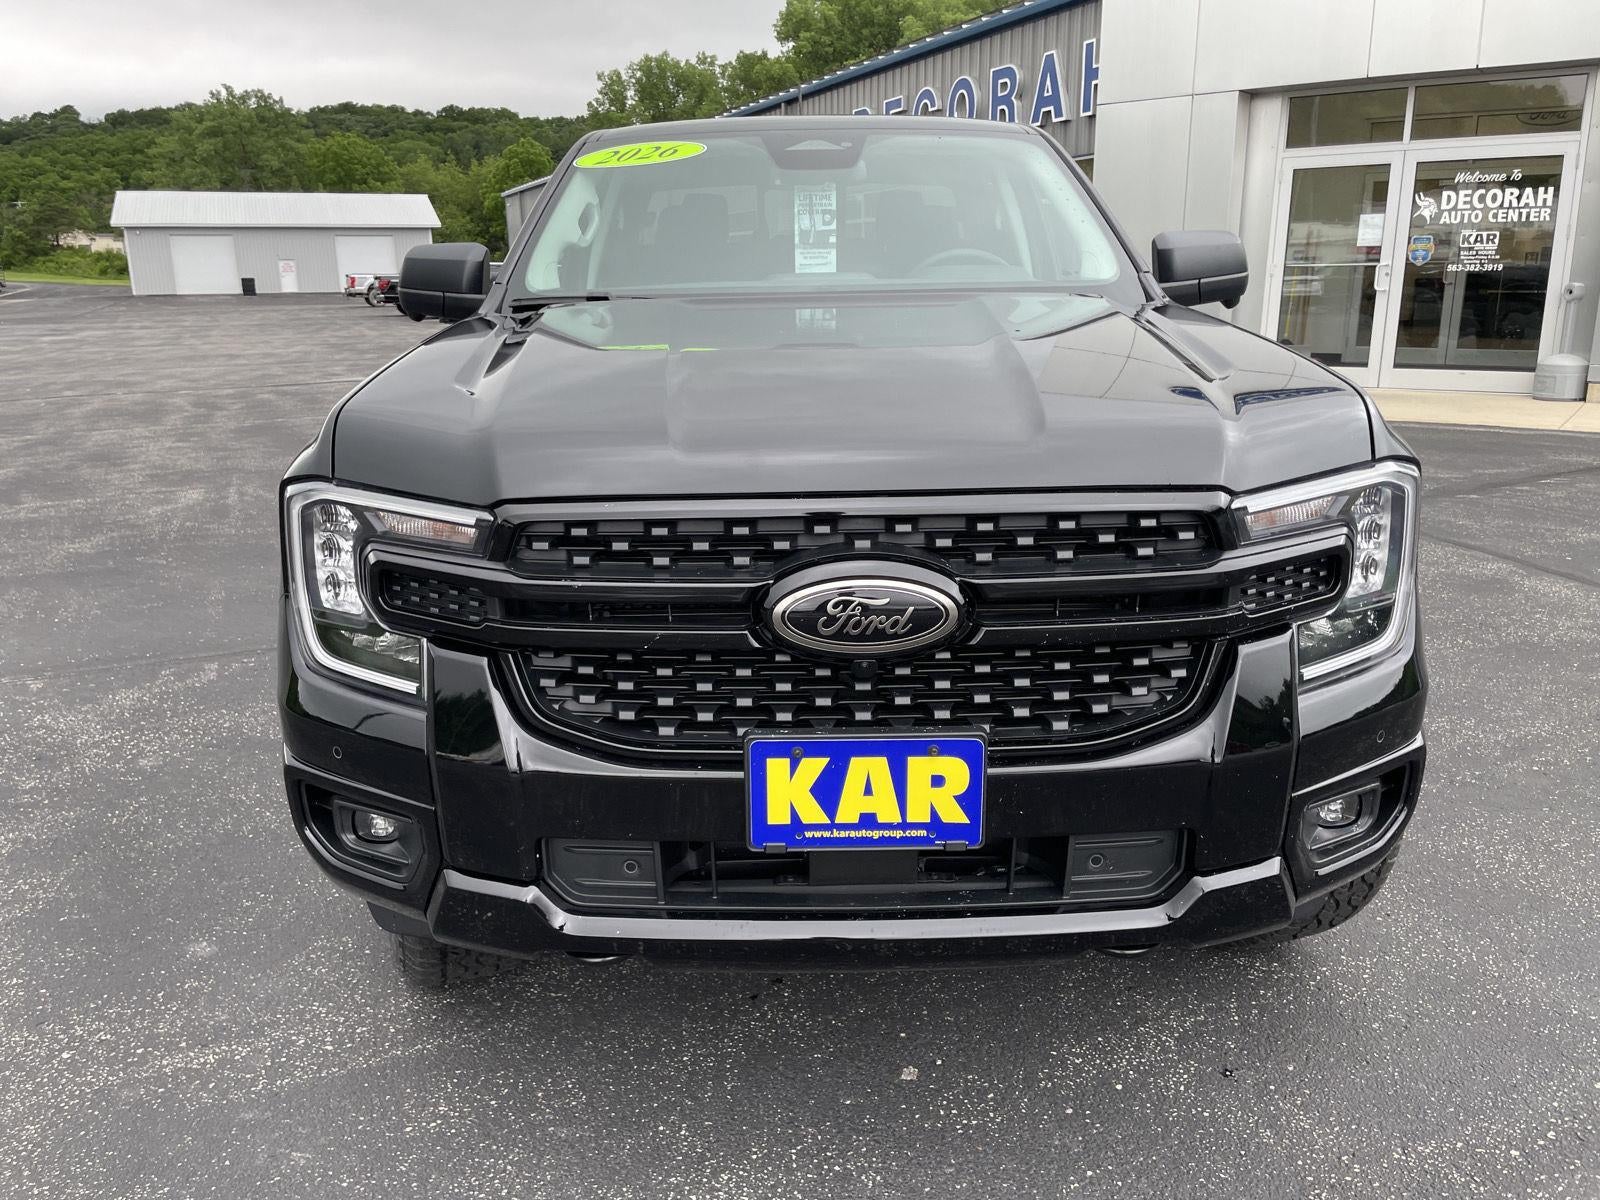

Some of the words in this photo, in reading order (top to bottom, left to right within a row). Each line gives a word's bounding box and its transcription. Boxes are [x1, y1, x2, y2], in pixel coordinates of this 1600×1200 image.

[593, 144, 686, 165] 2026
[1454, 171, 1507, 184] Welcome
[1510, 169, 1523, 181] To
[1440, 186, 1555, 210] DECORAH
[1439, 210, 1483, 224] AUTO
[1488, 208, 1551, 223] CENTER
[1461, 233, 1498, 246] KAR
[1446, 264, 1503, 272] 563-382-3919
[817, 596, 915, 636] Ford
[766, 756, 971, 825] KAR
[804, 828, 927, 839] www.karautogroup.com
